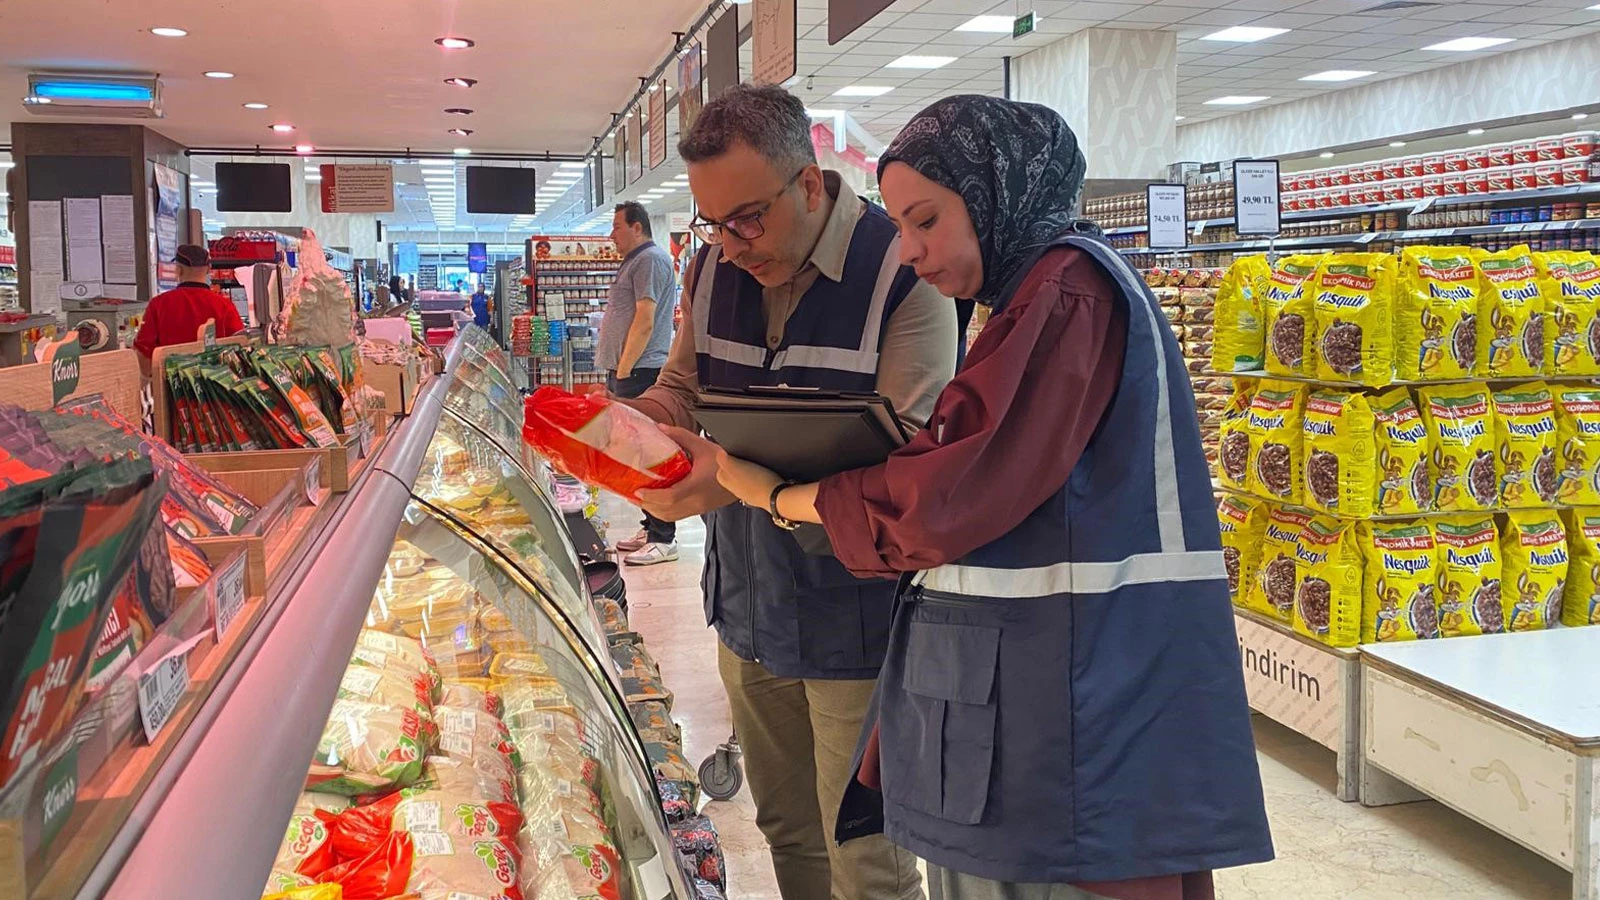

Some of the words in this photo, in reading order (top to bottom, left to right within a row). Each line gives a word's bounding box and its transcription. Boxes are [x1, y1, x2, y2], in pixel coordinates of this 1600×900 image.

[1242, 196, 1261, 205] 49,90
[1263, 196, 1274, 204] TL
[53, 359, 79, 383] Knorr
[1507, 416, 1556, 438] Nesquik
[1266, 524, 1301, 543] Nesqui
[1468, 533, 1494, 546] PAKET
[1383, 553, 1431, 575] Nesquik
[1447, 548, 1496, 568] Nesquik
[1240, 636, 1320, 702] indirim
